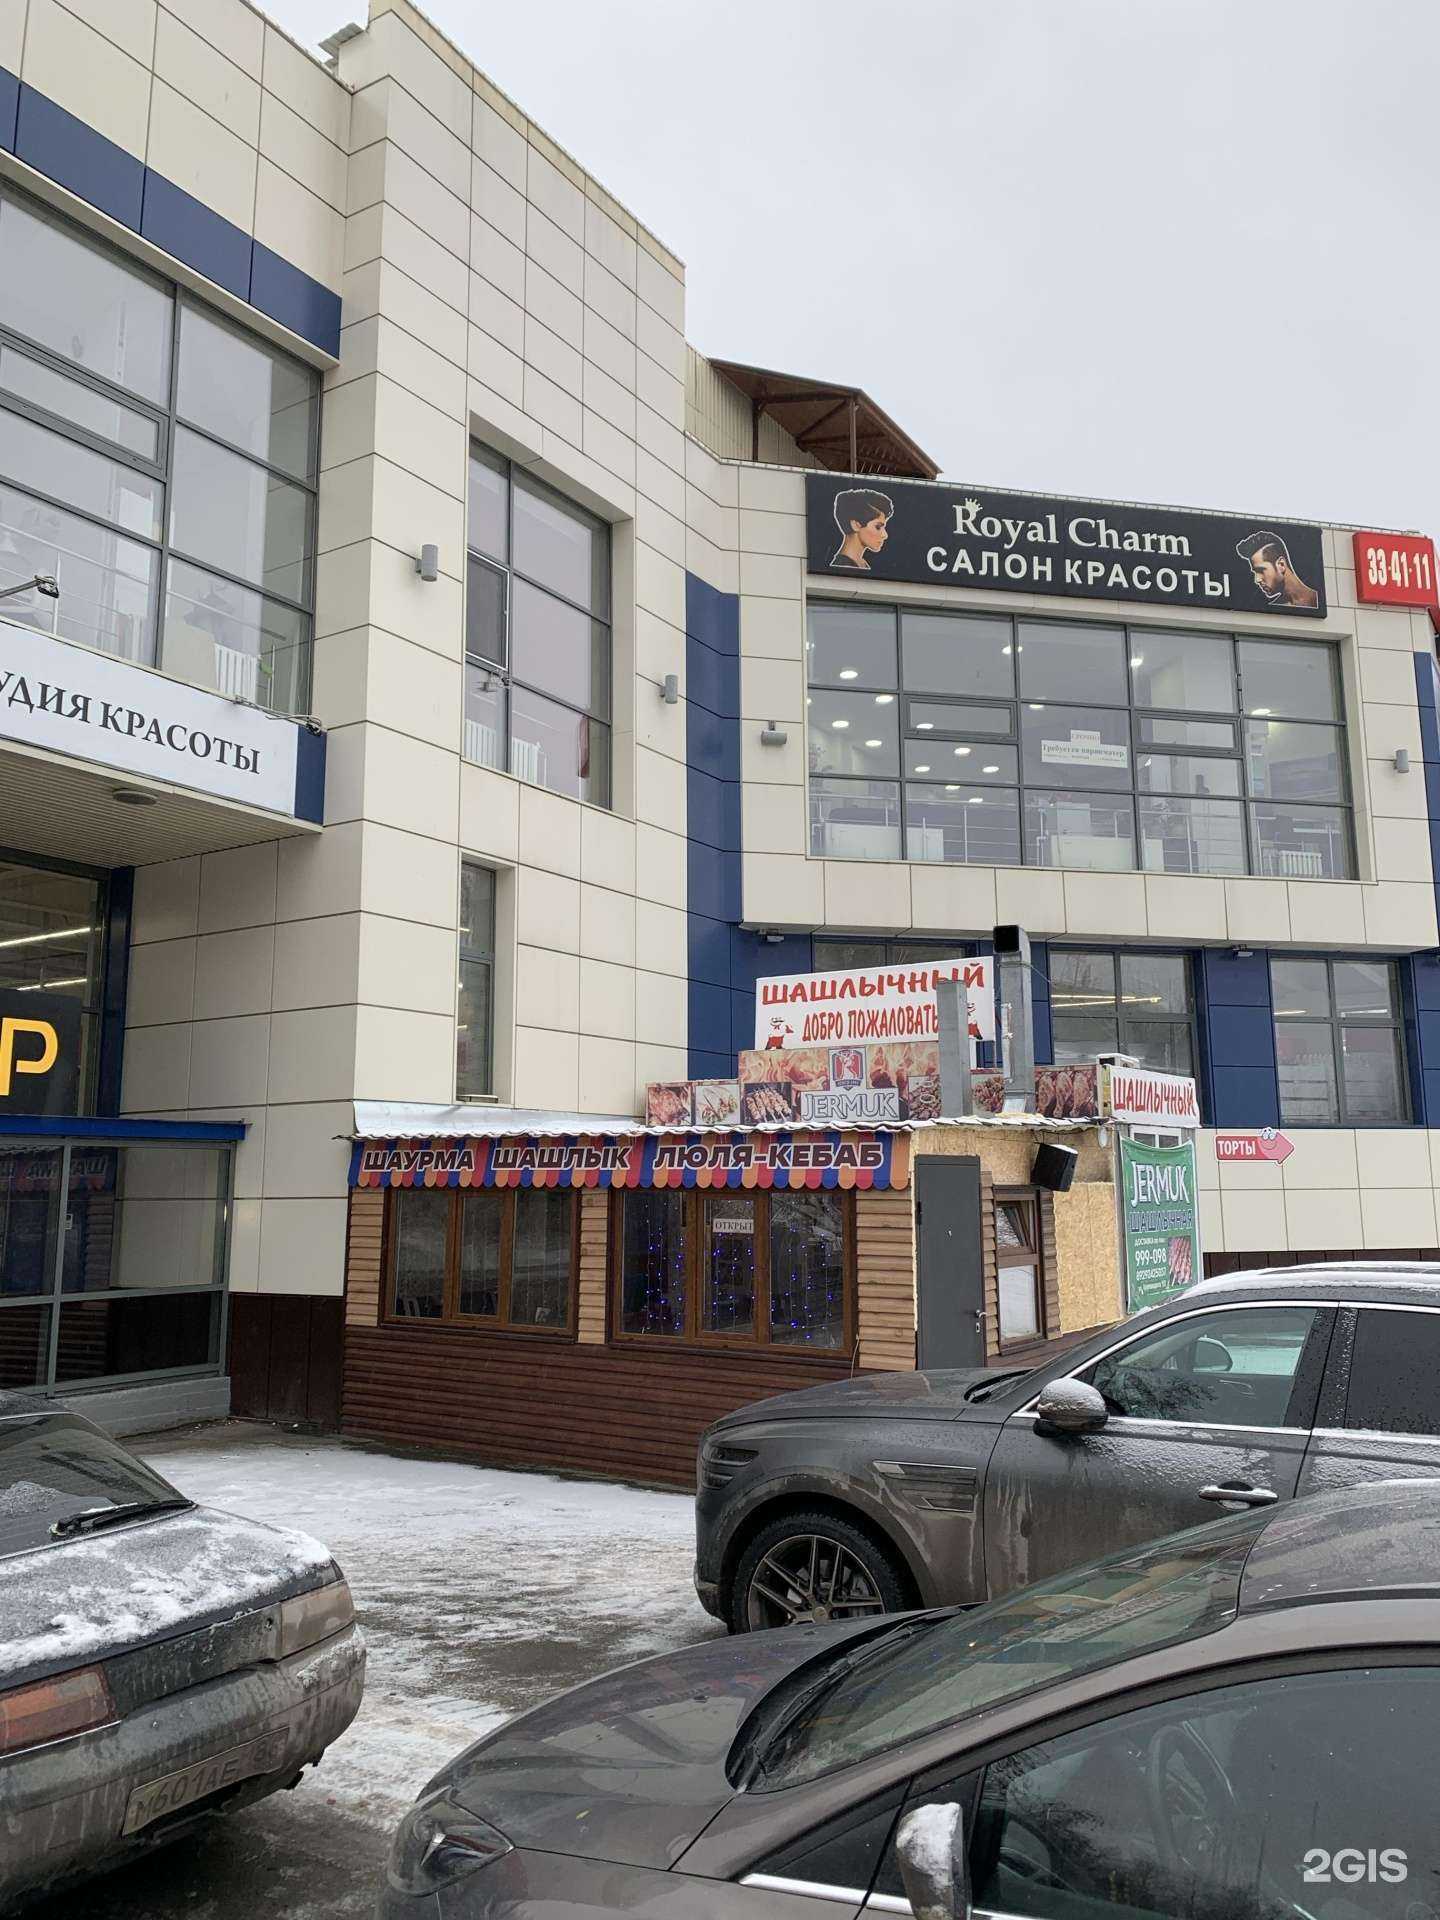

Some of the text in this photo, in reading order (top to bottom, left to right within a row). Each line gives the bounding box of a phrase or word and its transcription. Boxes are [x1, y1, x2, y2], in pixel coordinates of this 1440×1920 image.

[952, 503, 1193, 557] Royal Charm
[926, 545, 1232, 598] САЛОН КРАСОТЫ
[99, 700, 261, 775] КРАСОТЫ
[802, 1011, 844, 1042] ДОБРО
[802, 1091, 898, 1122] JERMUK
[1113, 1076, 1197, 1117] ШАШЛЫЧНЫЙ
[363, 1142, 885, 1171] ШАУРМА ШАШЛЫК ЛЮЛЯ-КЕБАБ
[1217, 1139, 1256, 1156] ТОРТЫ
[1130, 1160, 1190, 1208] JERMUK
[1128, 1208, 1193, 1234] ШАШЛЫЧНАЯ
[1135, 1248, 1167, 1266] 999-098
